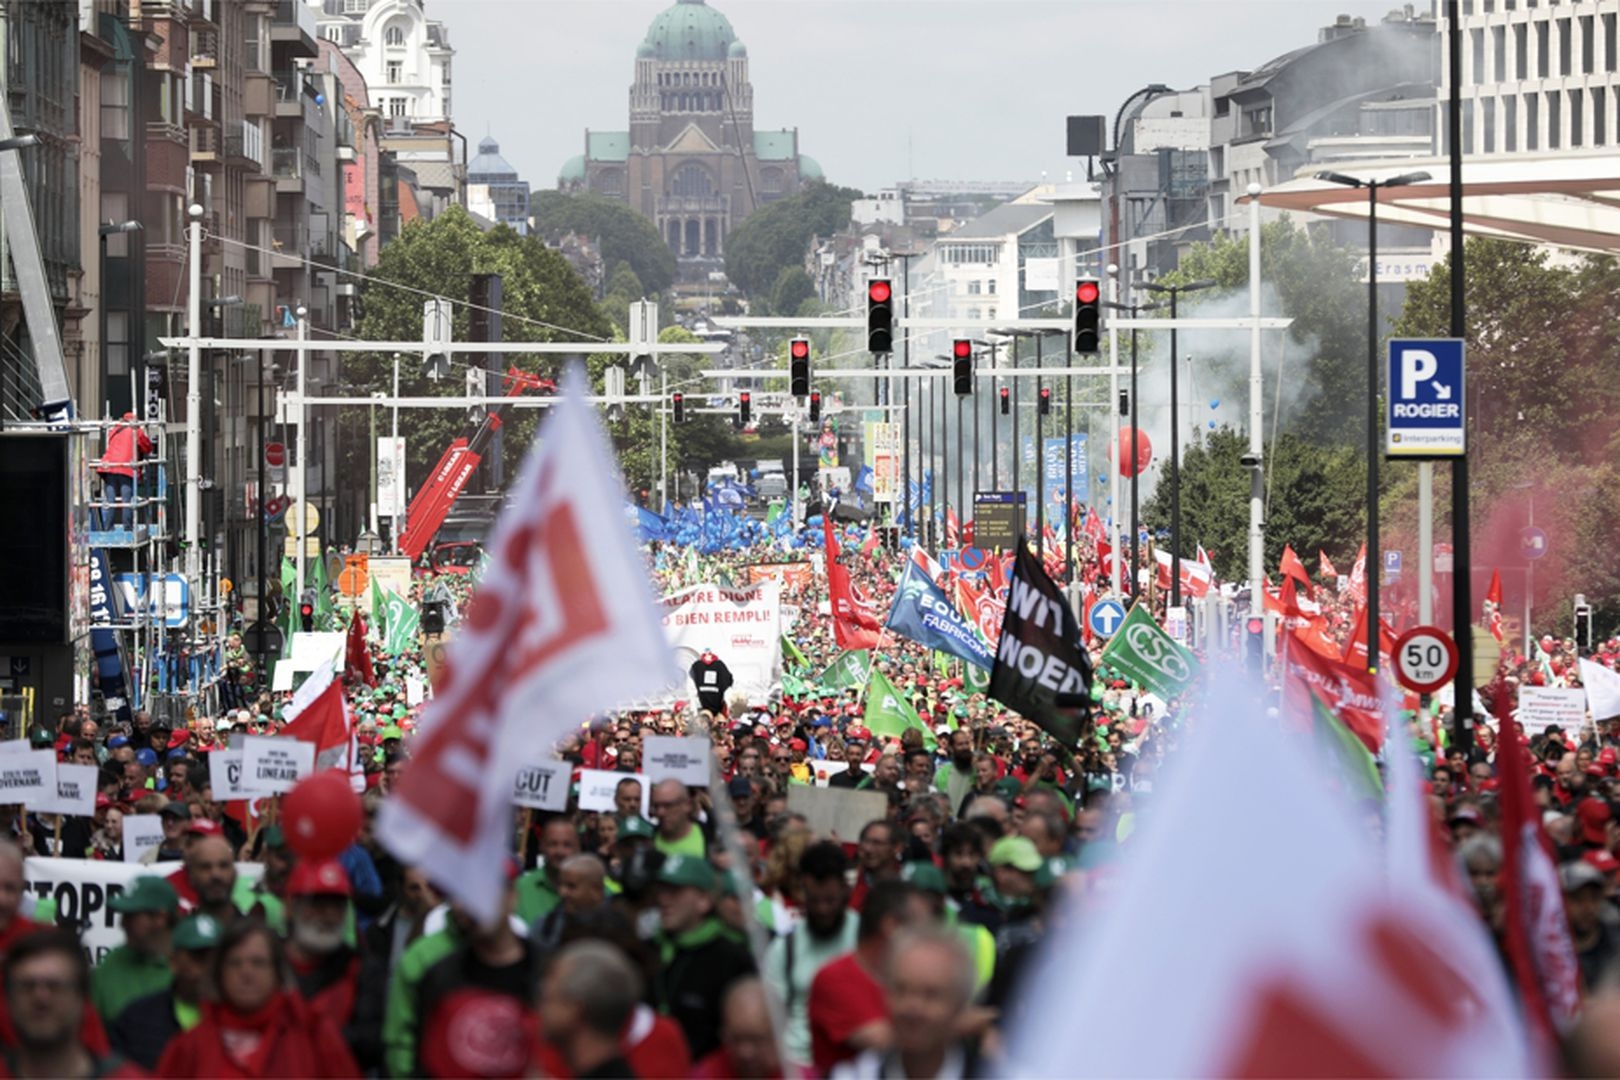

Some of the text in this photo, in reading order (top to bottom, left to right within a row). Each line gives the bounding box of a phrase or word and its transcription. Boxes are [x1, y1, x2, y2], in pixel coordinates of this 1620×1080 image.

[1401, 349, 1438, 399] P
[1393, 403, 1460, 418] ROGIER
[1388, 552, 1398, 566] P
[719, 588, 763, 603] DIGNE
[675, 610, 709, 626] BIEN
[713, 609, 771, 624] REMPLI!
[922, 613, 988, 658] FABRICOM
[1132, 625, 1187, 675] CSC
[1407, 644, 1442, 667] 50
[1414, 668, 1434, 679] km
[515, 768, 553, 794] CUT
